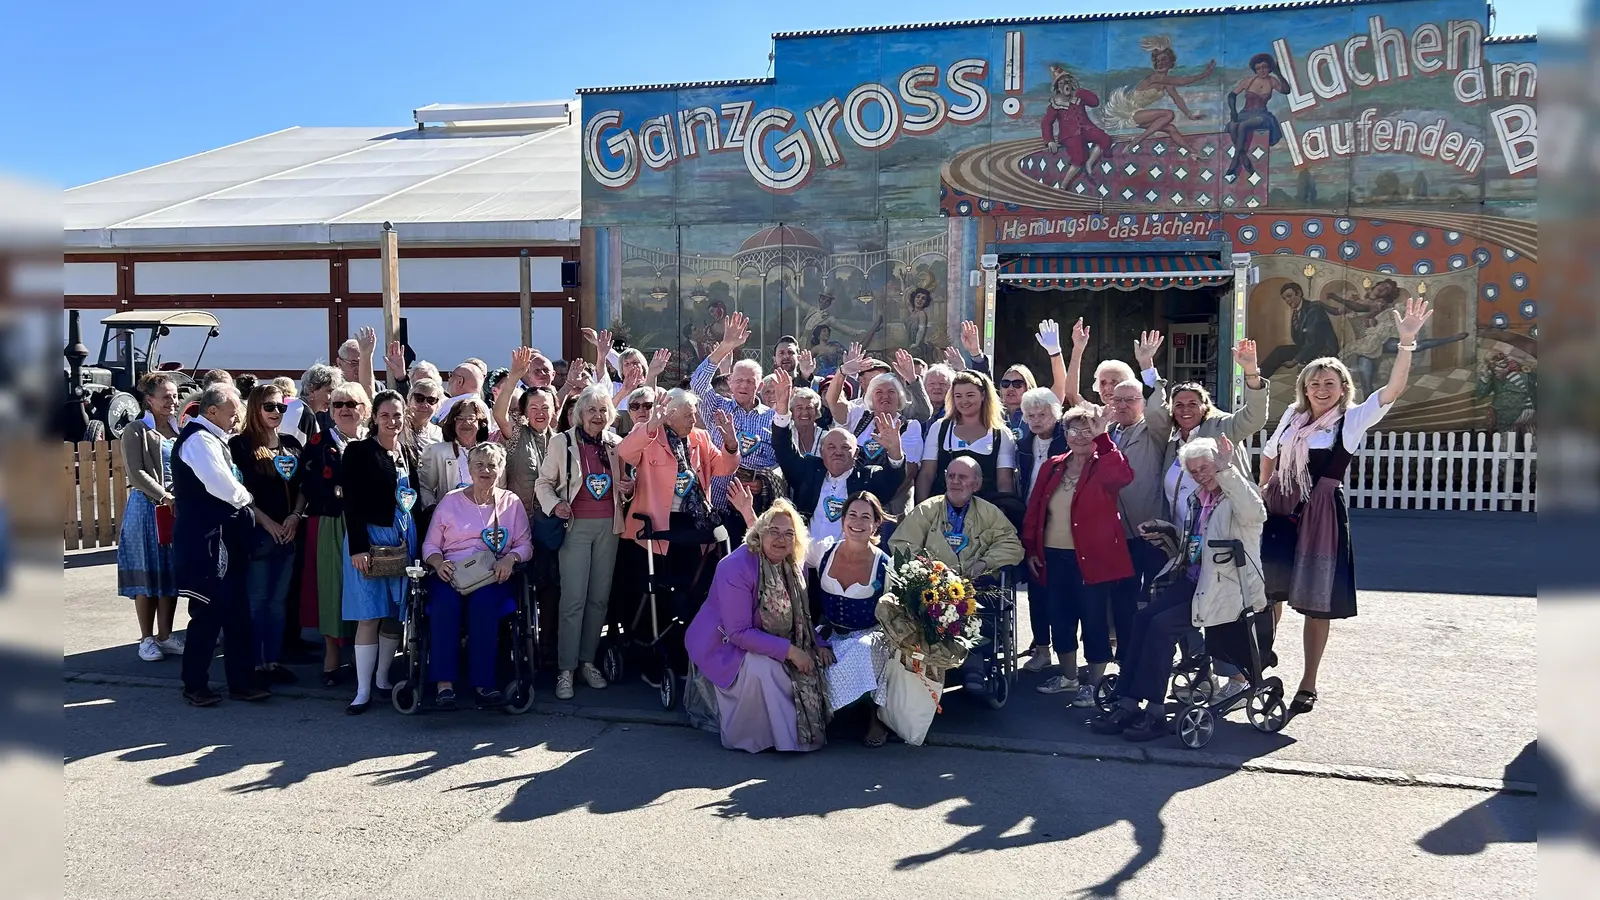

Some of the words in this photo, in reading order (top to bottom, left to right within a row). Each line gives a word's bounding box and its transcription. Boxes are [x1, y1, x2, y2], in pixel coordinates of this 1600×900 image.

[1273, 16, 1482, 113] Lachen
[1453, 62, 1537, 103] am
[584, 101, 754, 187] Ganz
[1281, 108, 1485, 174] laufenden
[1108, 223, 1139, 238] das
[1142, 217, 1213, 236] Lachen!
